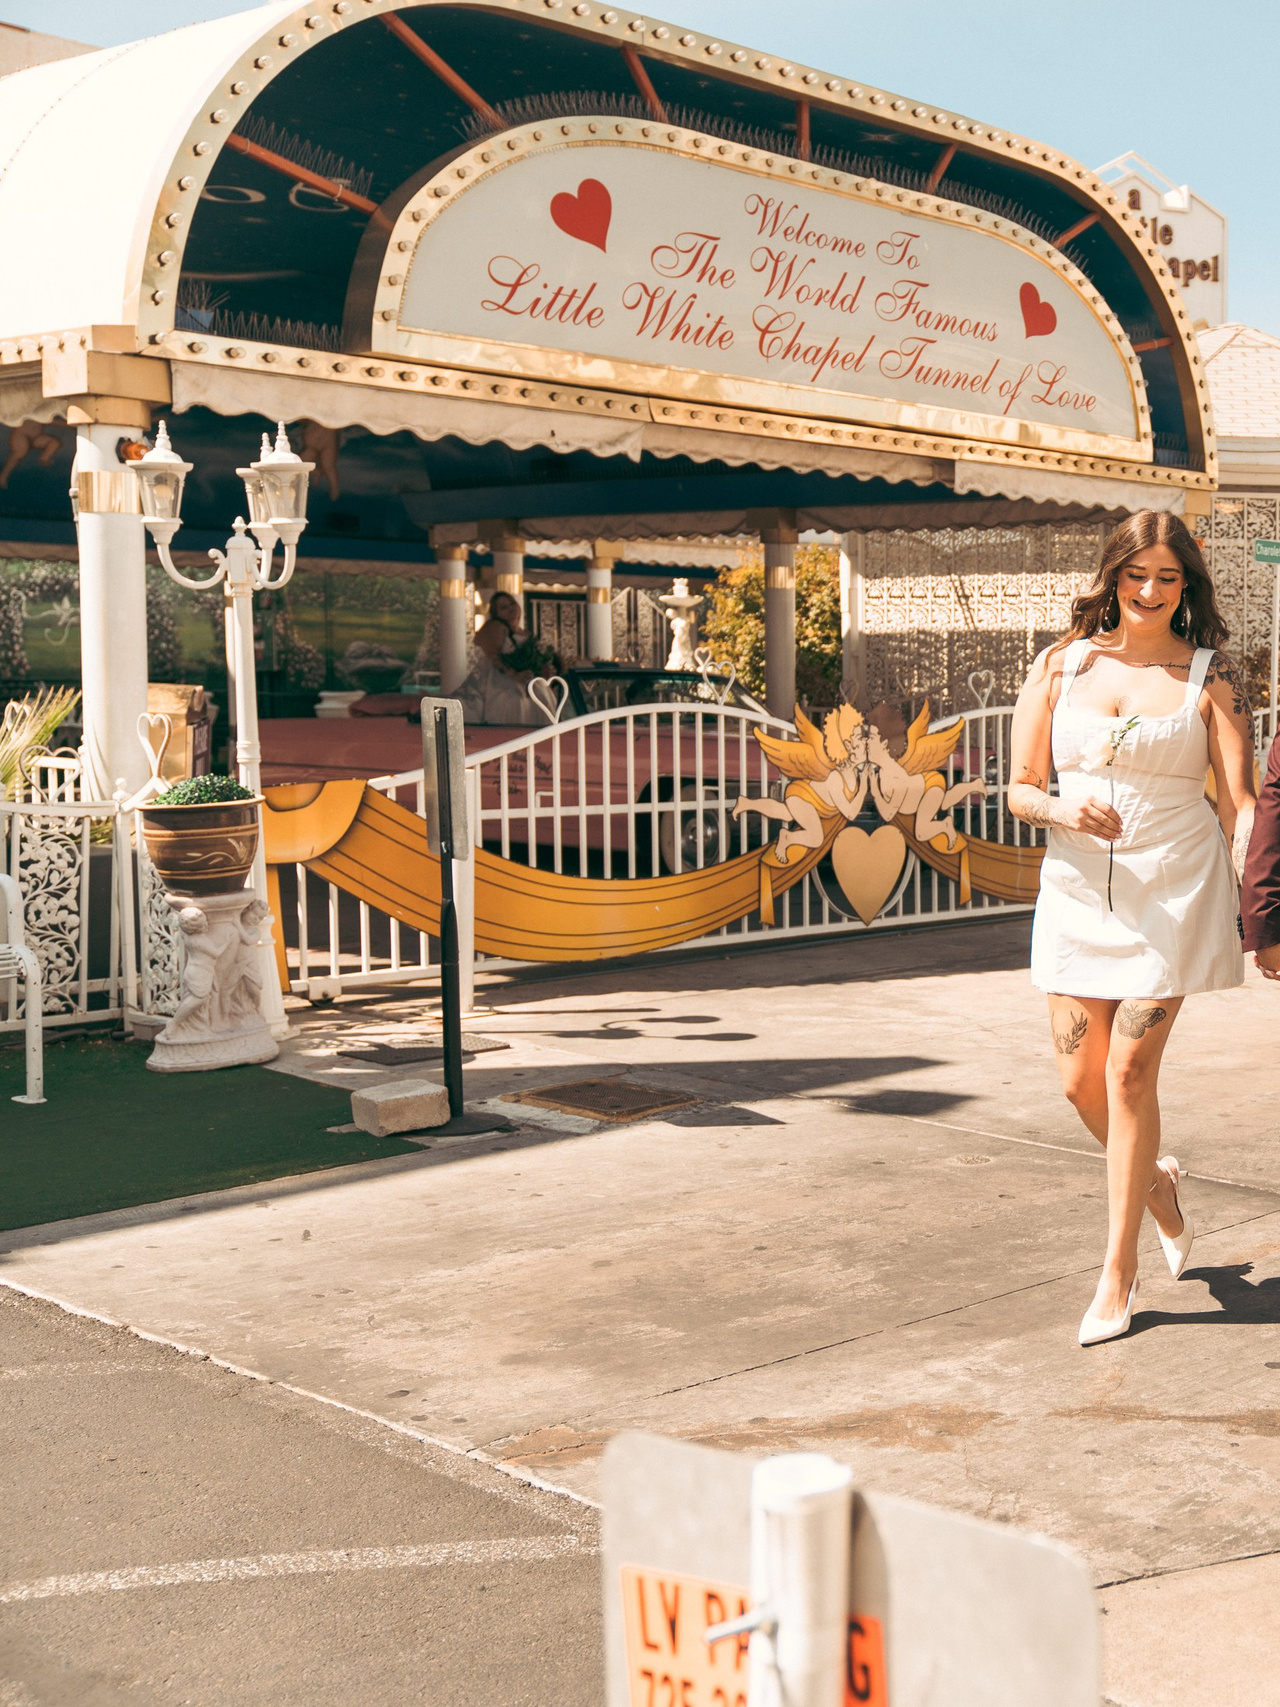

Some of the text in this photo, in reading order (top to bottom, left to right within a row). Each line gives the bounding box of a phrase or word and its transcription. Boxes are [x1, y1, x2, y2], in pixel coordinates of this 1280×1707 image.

[744, 193, 921, 269] Welcome To
[1128, 189, 1141, 210] a
[651, 232, 999, 342] The World Famous
[1162, 255, 1219, 287] apel
[481, 255, 1097, 415] Little White Chapel Tunnel of Love
[636, 1575, 680, 1656] LV
